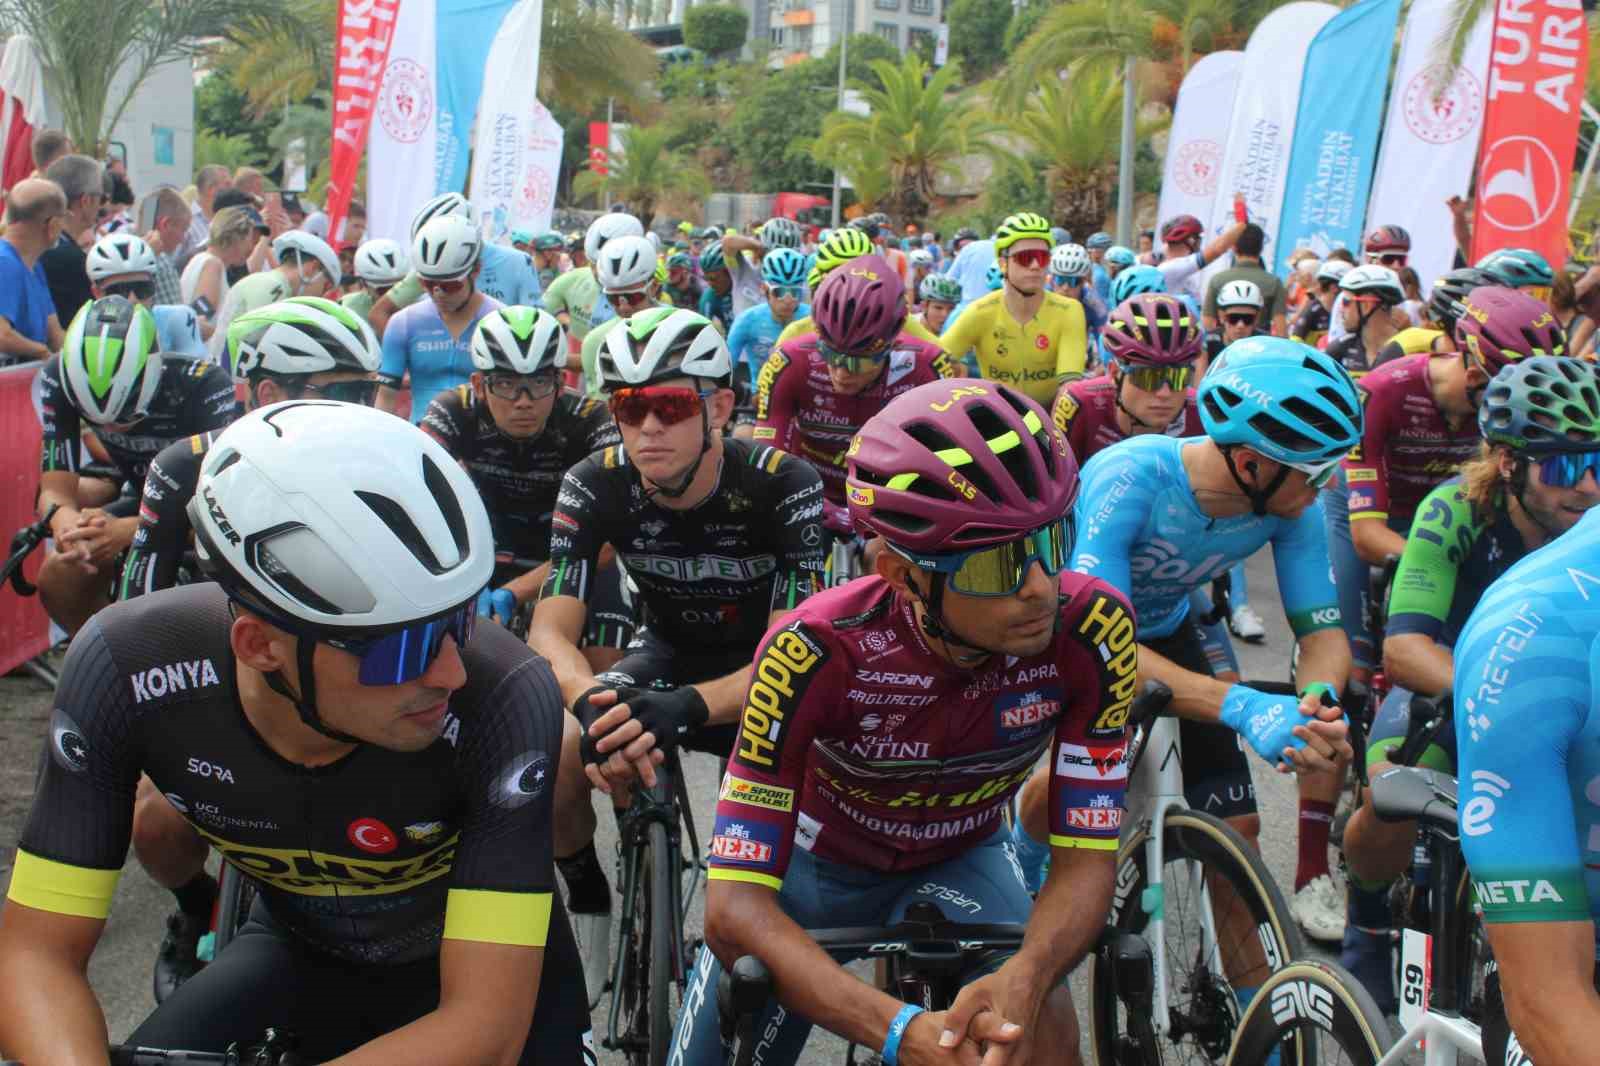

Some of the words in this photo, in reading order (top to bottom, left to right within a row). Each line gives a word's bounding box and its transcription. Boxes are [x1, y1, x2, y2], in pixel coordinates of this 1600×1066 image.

[1312, 131, 1339, 226] ALAADDIN
[947, 471, 977, 501] LAS
[202, 485, 242, 547] LAZER
[130, 656, 221, 704] KONYA
[186, 758, 235, 785] SORA
[731, 790, 789, 808] SPECIALIST
[751, 786, 791, 800] SPORT
[1404, 963, 1425, 1008] 65
